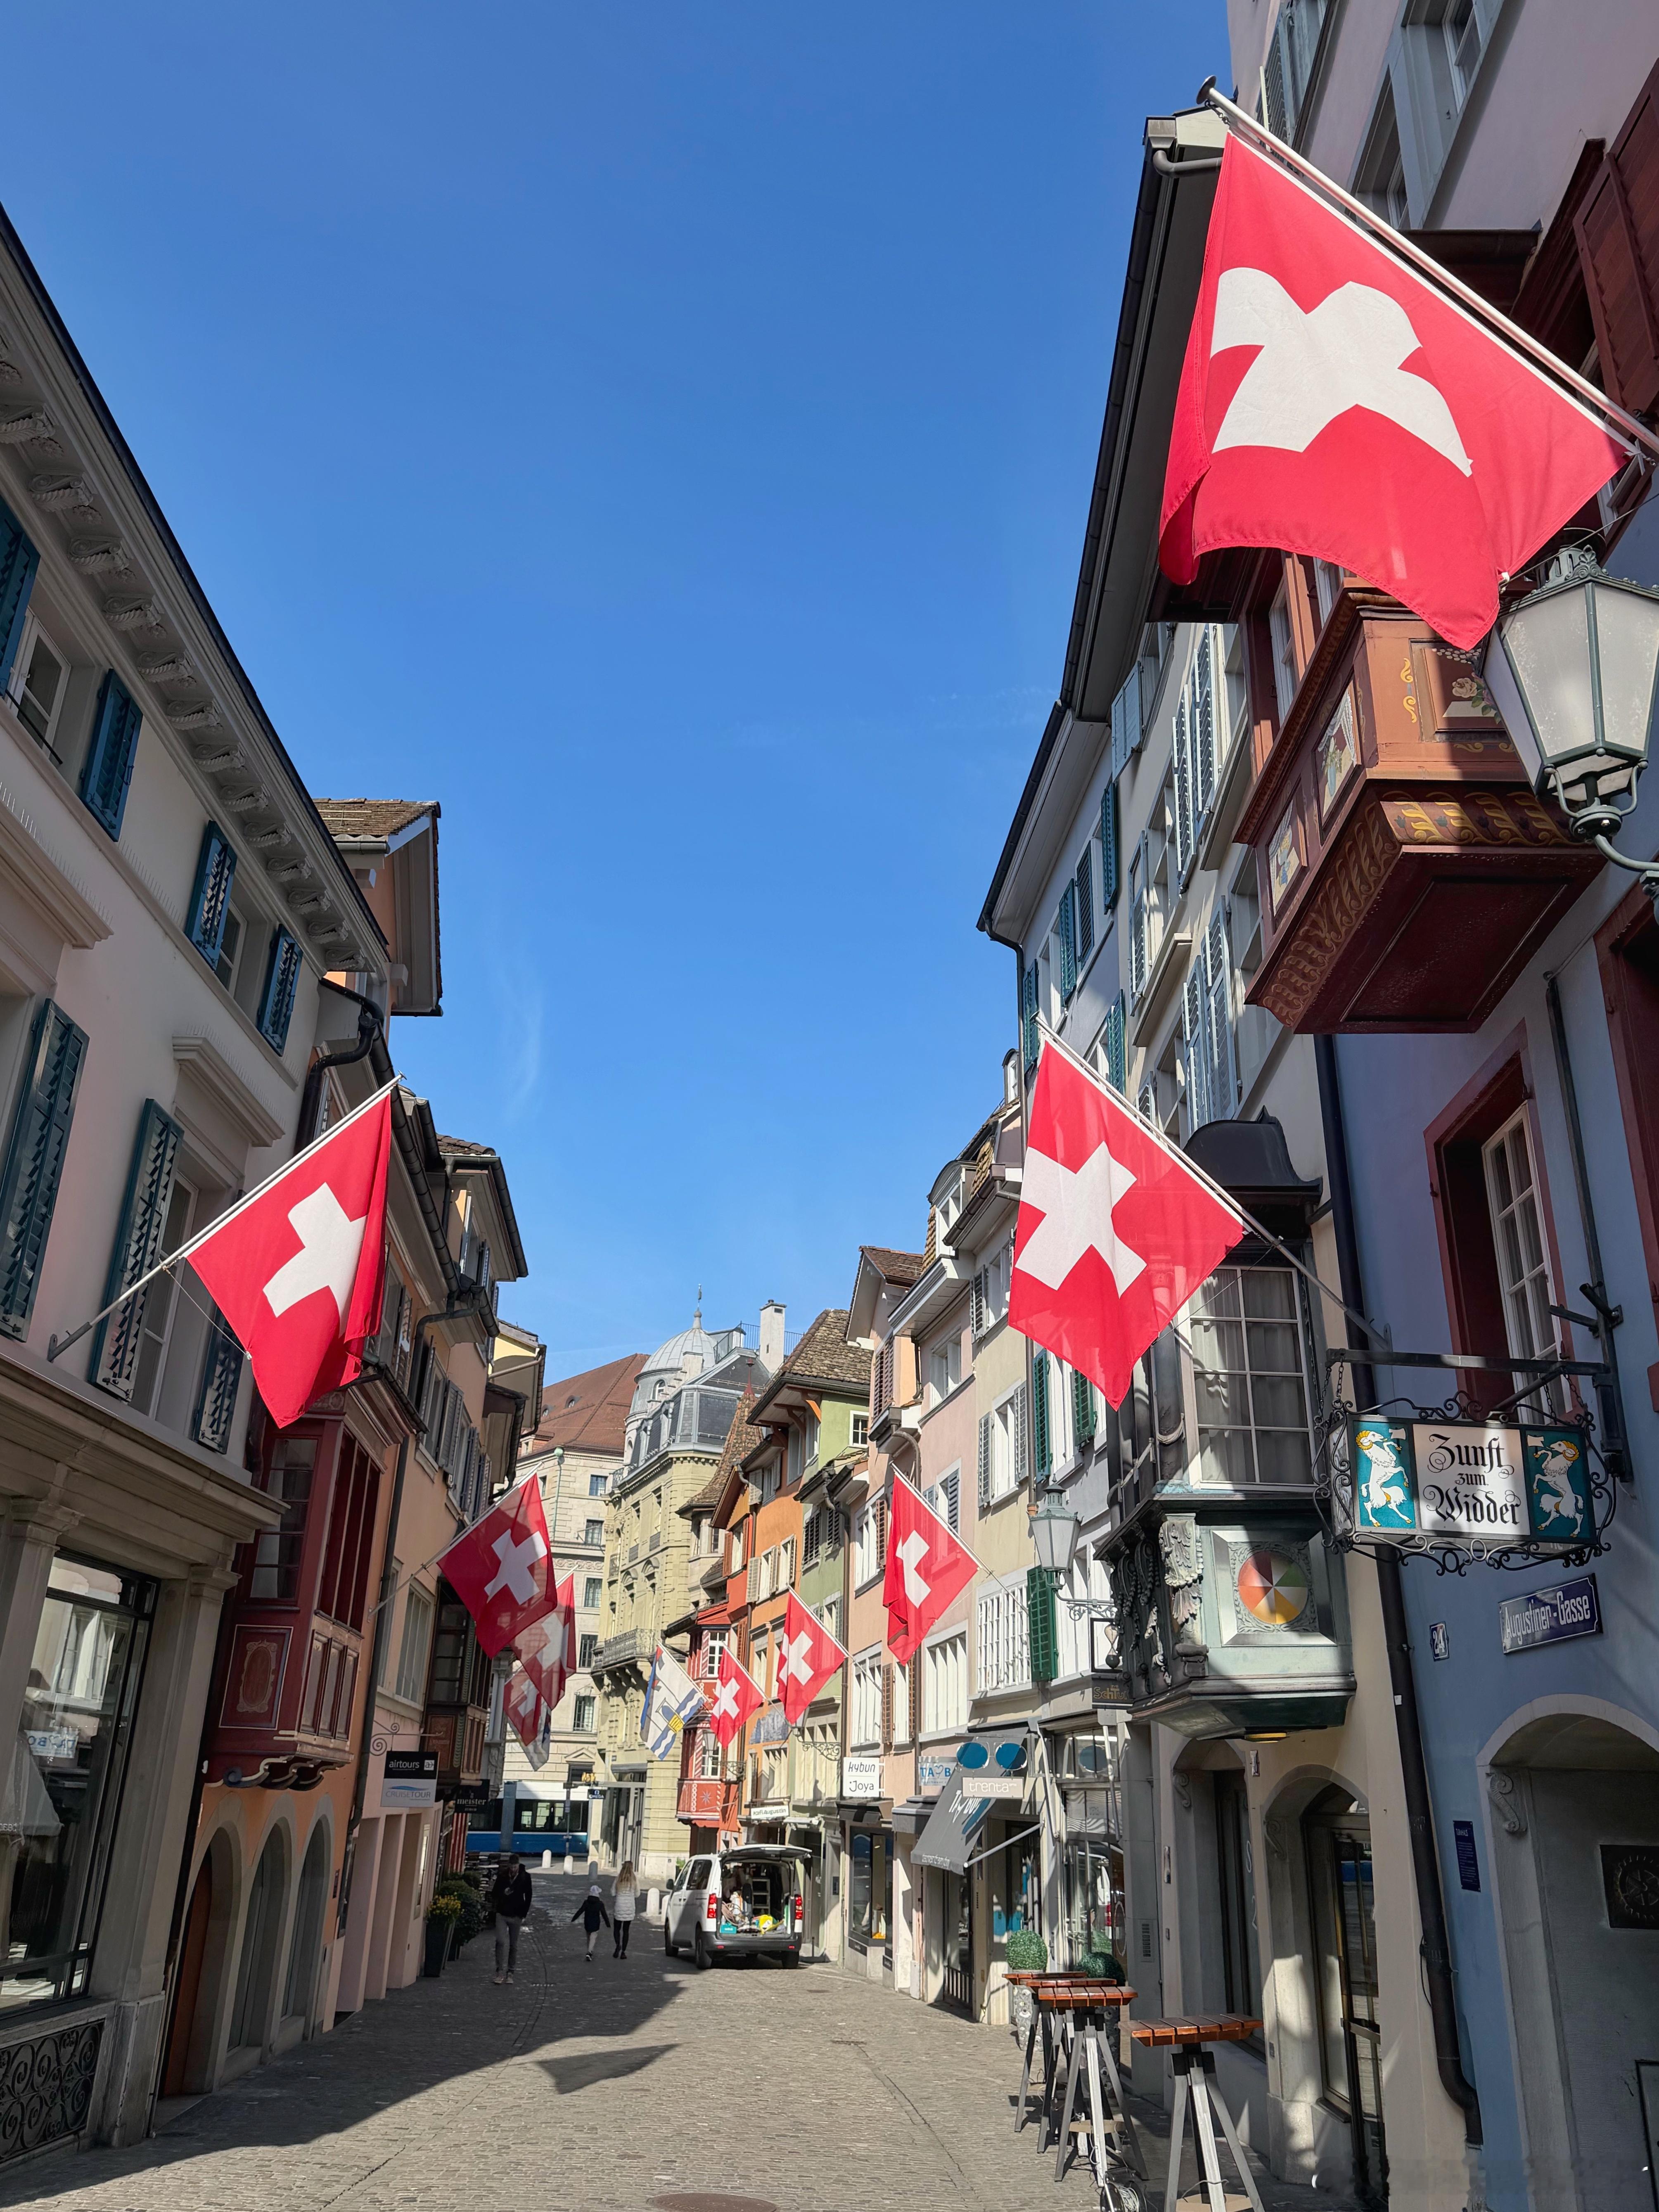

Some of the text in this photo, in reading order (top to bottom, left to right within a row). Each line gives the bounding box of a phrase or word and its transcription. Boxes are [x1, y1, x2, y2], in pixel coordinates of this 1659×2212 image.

[1427, 1433, 1514, 1479] Zunft
[1455, 1473, 1488, 1486] zum
[1423, 1484, 1521, 1525] Widder
[1433, 1628, 1445, 1654] 24
[389, 1760, 420, 1769] airtours
[848, 1762, 875, 1772] kybun
[849, 1780, 874, 1793] Joya
[969, 1782, 1009, 1792] trenta
